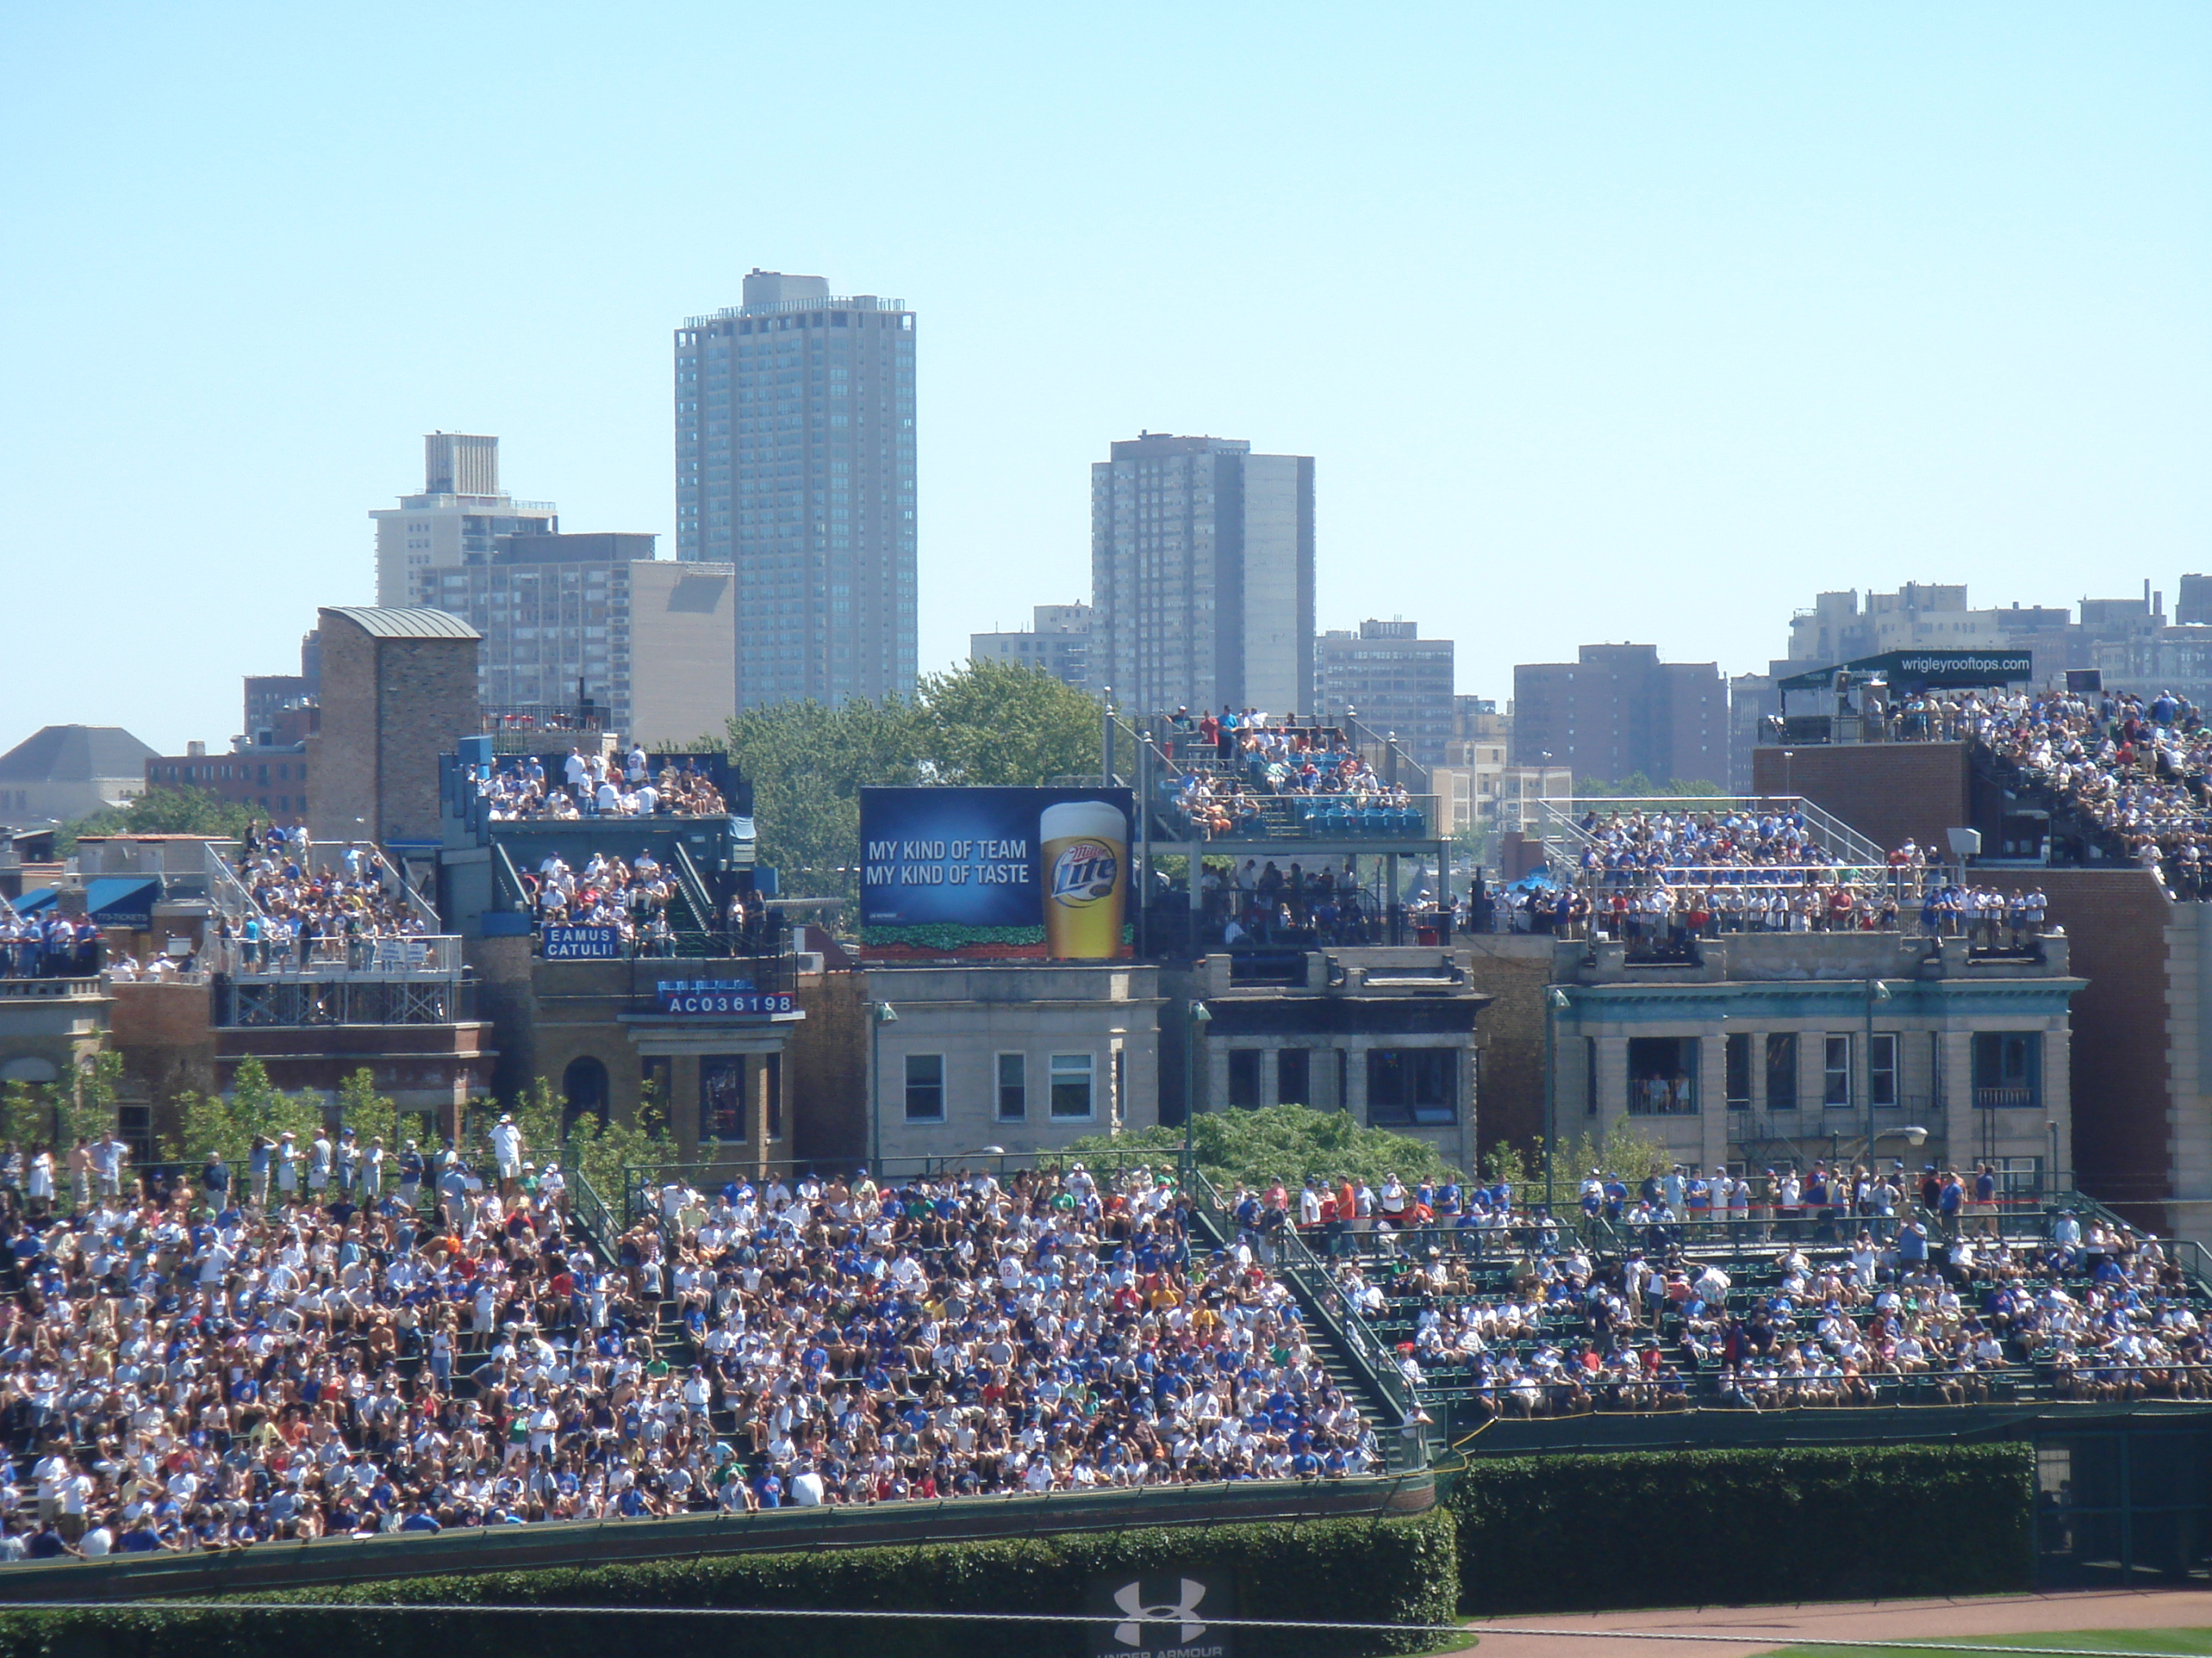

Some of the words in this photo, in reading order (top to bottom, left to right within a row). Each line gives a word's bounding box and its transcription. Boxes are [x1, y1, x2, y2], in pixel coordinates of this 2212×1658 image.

[1902, 657, 2030, 673] wrigleyrooftops.com
[869, 841, 897, 860] MY
[904, 841, 945, 860] KIND
[951, 840, 972, 859] OF
[977, 840, 1027, 859] TEAM
[866, 866, 895, 886] MY
[901, 866, 944, 885] KIND
[948, 865, 970, 884] OF
[975, 864, 1029, 883] TASTE
[550, 930, 610, 942] EAMUS
[548, 944, 613, 956] CATULI!
[670, 996, 791, 1012] AC036198
[1157, 1646, 1222, 1658] ARMOUR
